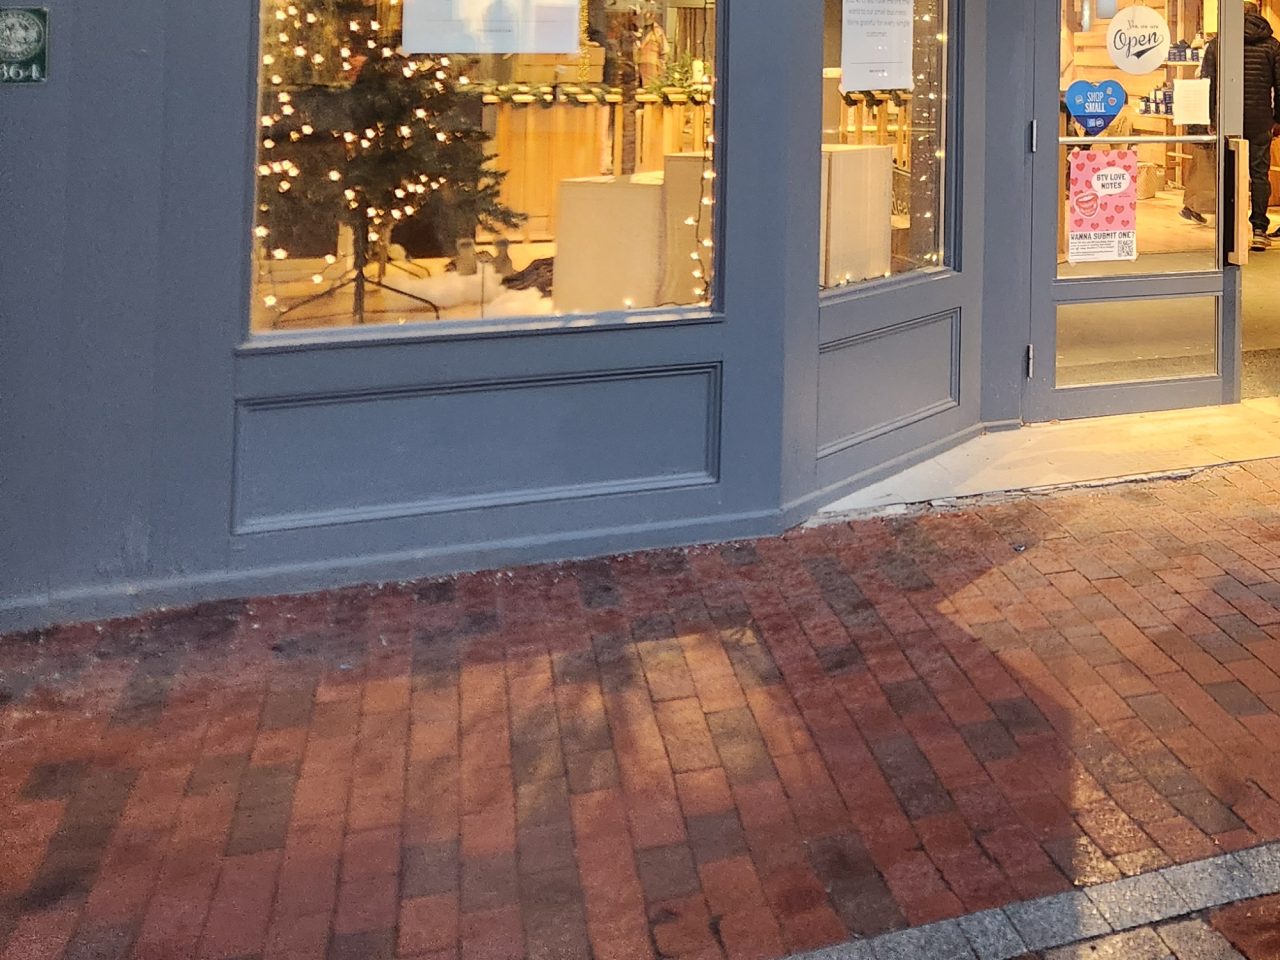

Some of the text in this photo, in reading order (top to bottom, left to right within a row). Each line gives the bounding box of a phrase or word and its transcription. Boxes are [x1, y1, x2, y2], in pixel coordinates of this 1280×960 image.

[1113, 28, 1160, 59] Open
[1087, 91, 1104, 102] SHOP
[1084, 102, 1106, 113] SMALL
[1096, 173, 1126, 182] BTV LOVE
[1101, 182, 1122, 190] NOTES
[1070, 231, 1135, 241] WANNA SUBMIT ONE?
